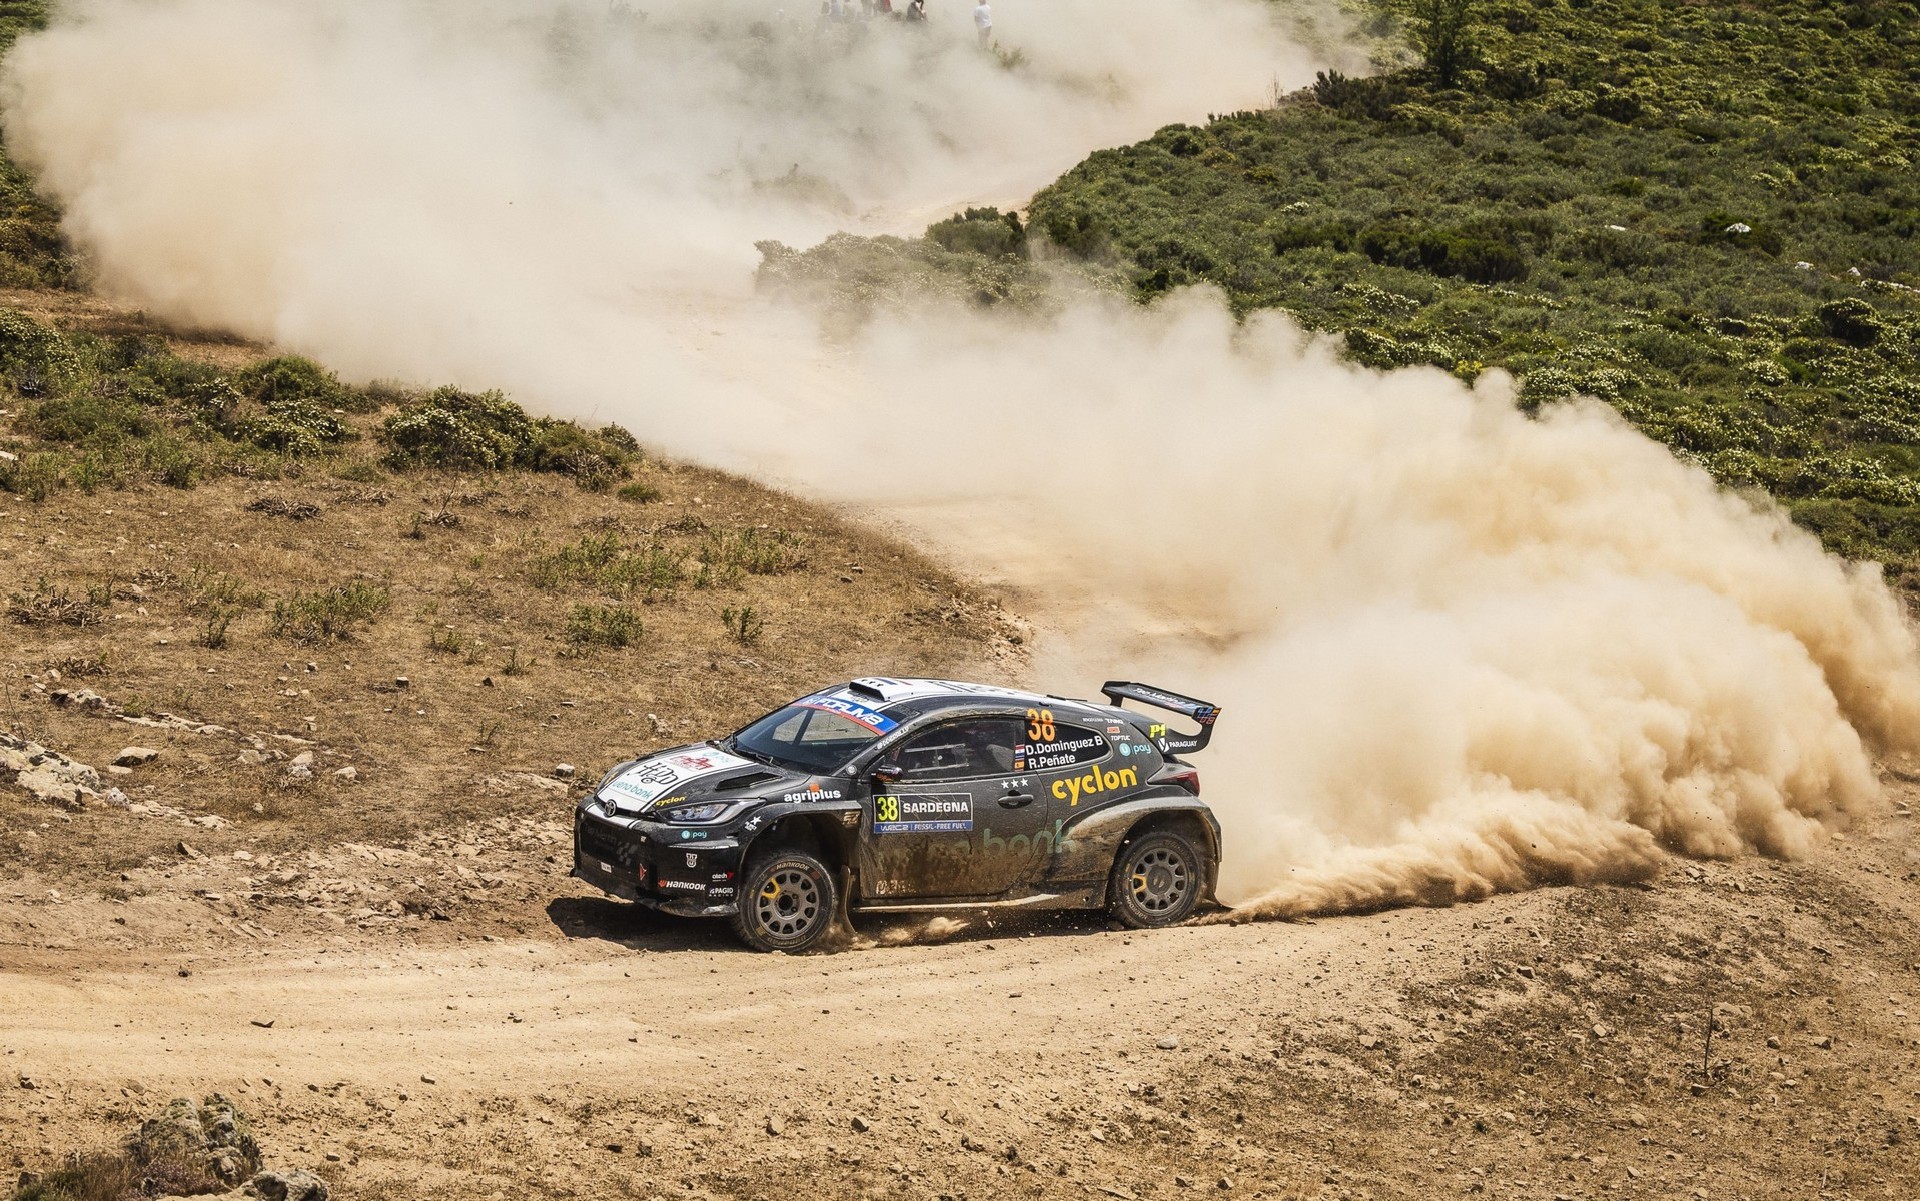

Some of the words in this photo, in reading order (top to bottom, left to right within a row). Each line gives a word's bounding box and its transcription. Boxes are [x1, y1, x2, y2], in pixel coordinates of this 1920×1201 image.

[815, 698, 884, 725] FORUM8
[1027, 708, 1055, 741] 38
[1149, 723, 1166, 738] P1
[1025, 737, 1095, 755] D.Dominguez
[1094, 735, 1104, 746] B
[1133, 744, 1152, 756] pay
[1168, 740, 1198, 748] PARAGUAY
[1028, 754, 1076, 769] R.Peñate
[630, 784, 653, 799] bank
[1051, 764, 1137, 806] cyclon
[656, 796, 686, 806] cyclon
[784, 789, 842, 804] agriplus
[877, 797, 898, 821] 38
[903, 802, 969, 813] SARDEGNA
[880, 824, 909, 832] WRC2
[914, 823, 951, 831] FOSSIL-FREE
[952, 822, 967, 830] FUEL
[692, 831, 707, 839] pay
